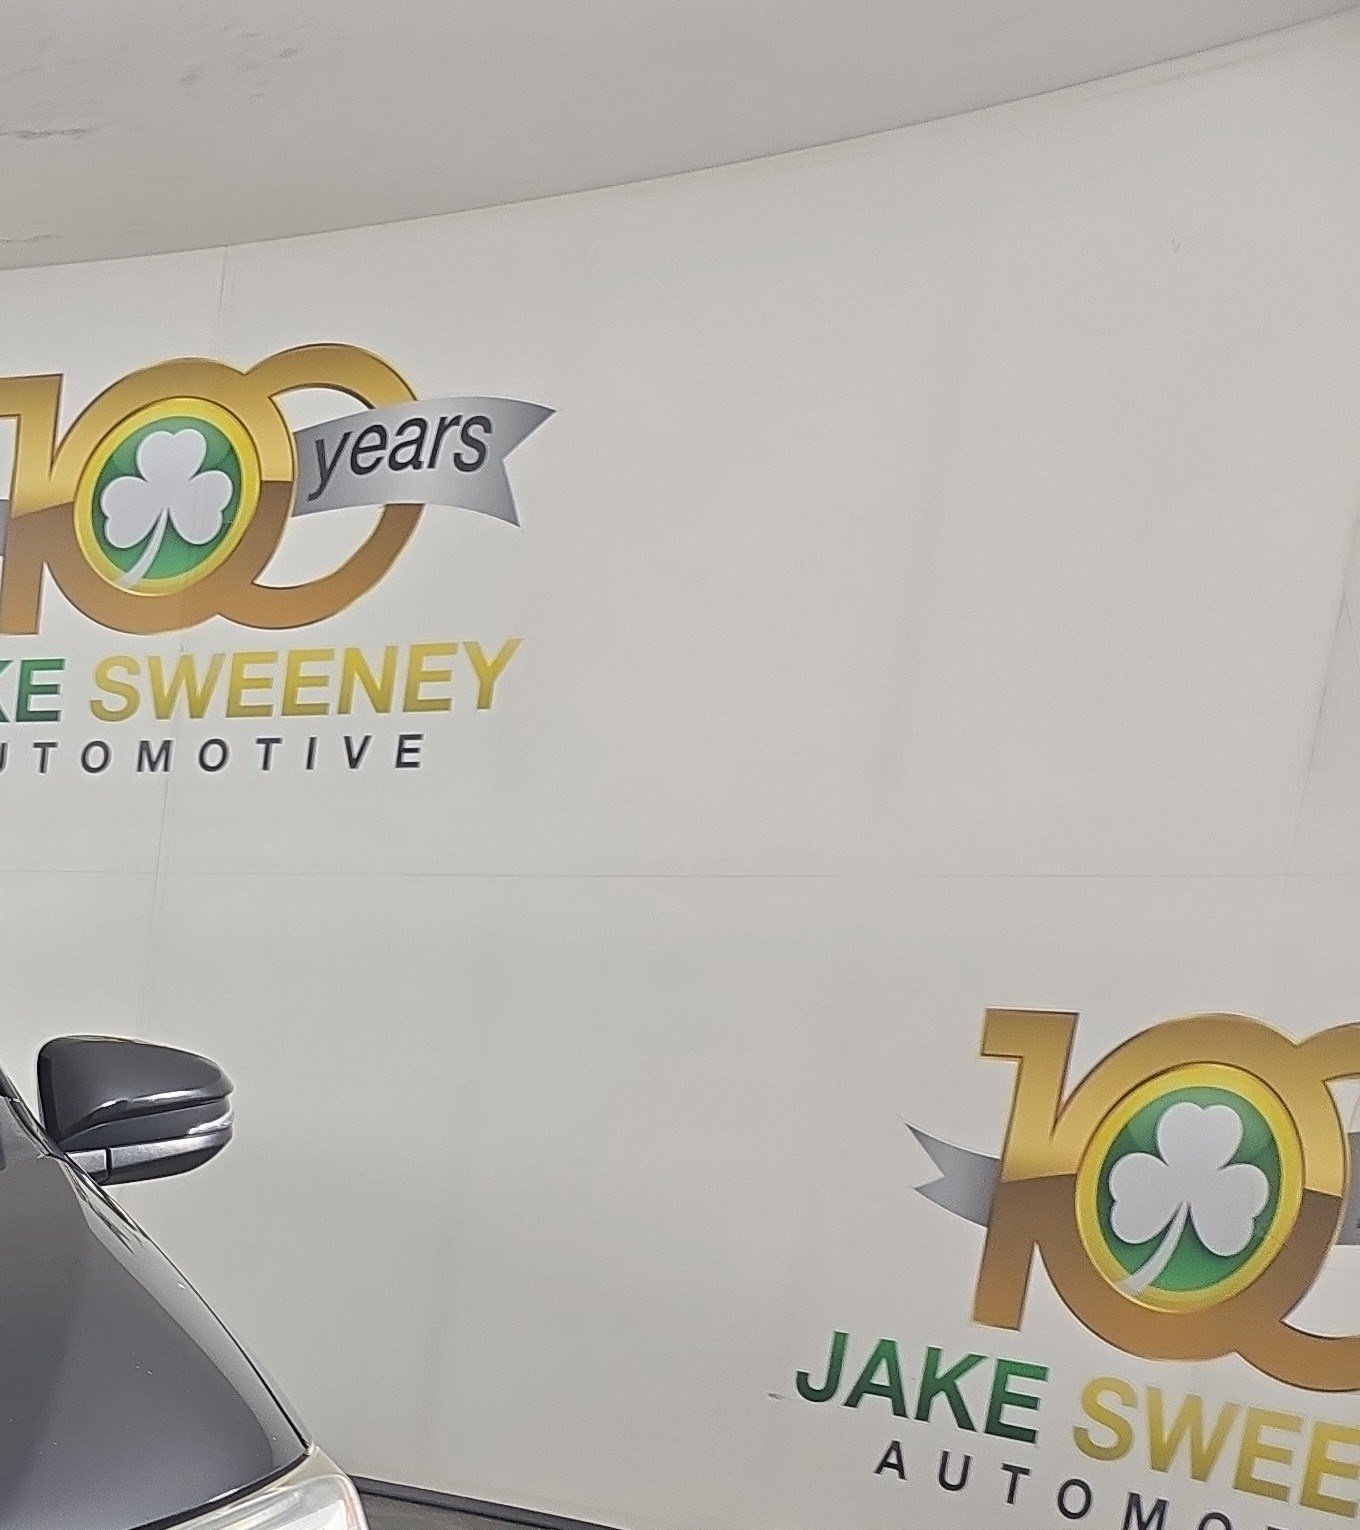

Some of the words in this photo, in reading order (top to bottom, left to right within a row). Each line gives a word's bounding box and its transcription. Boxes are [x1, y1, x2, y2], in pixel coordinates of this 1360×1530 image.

[308, 412, 493, 502] years
[90, 638, 522, 723] SWEENEY
[796, 1331, 1050, 1444] JAKE
[1073, 1377, 1360, 1519] SWEE
